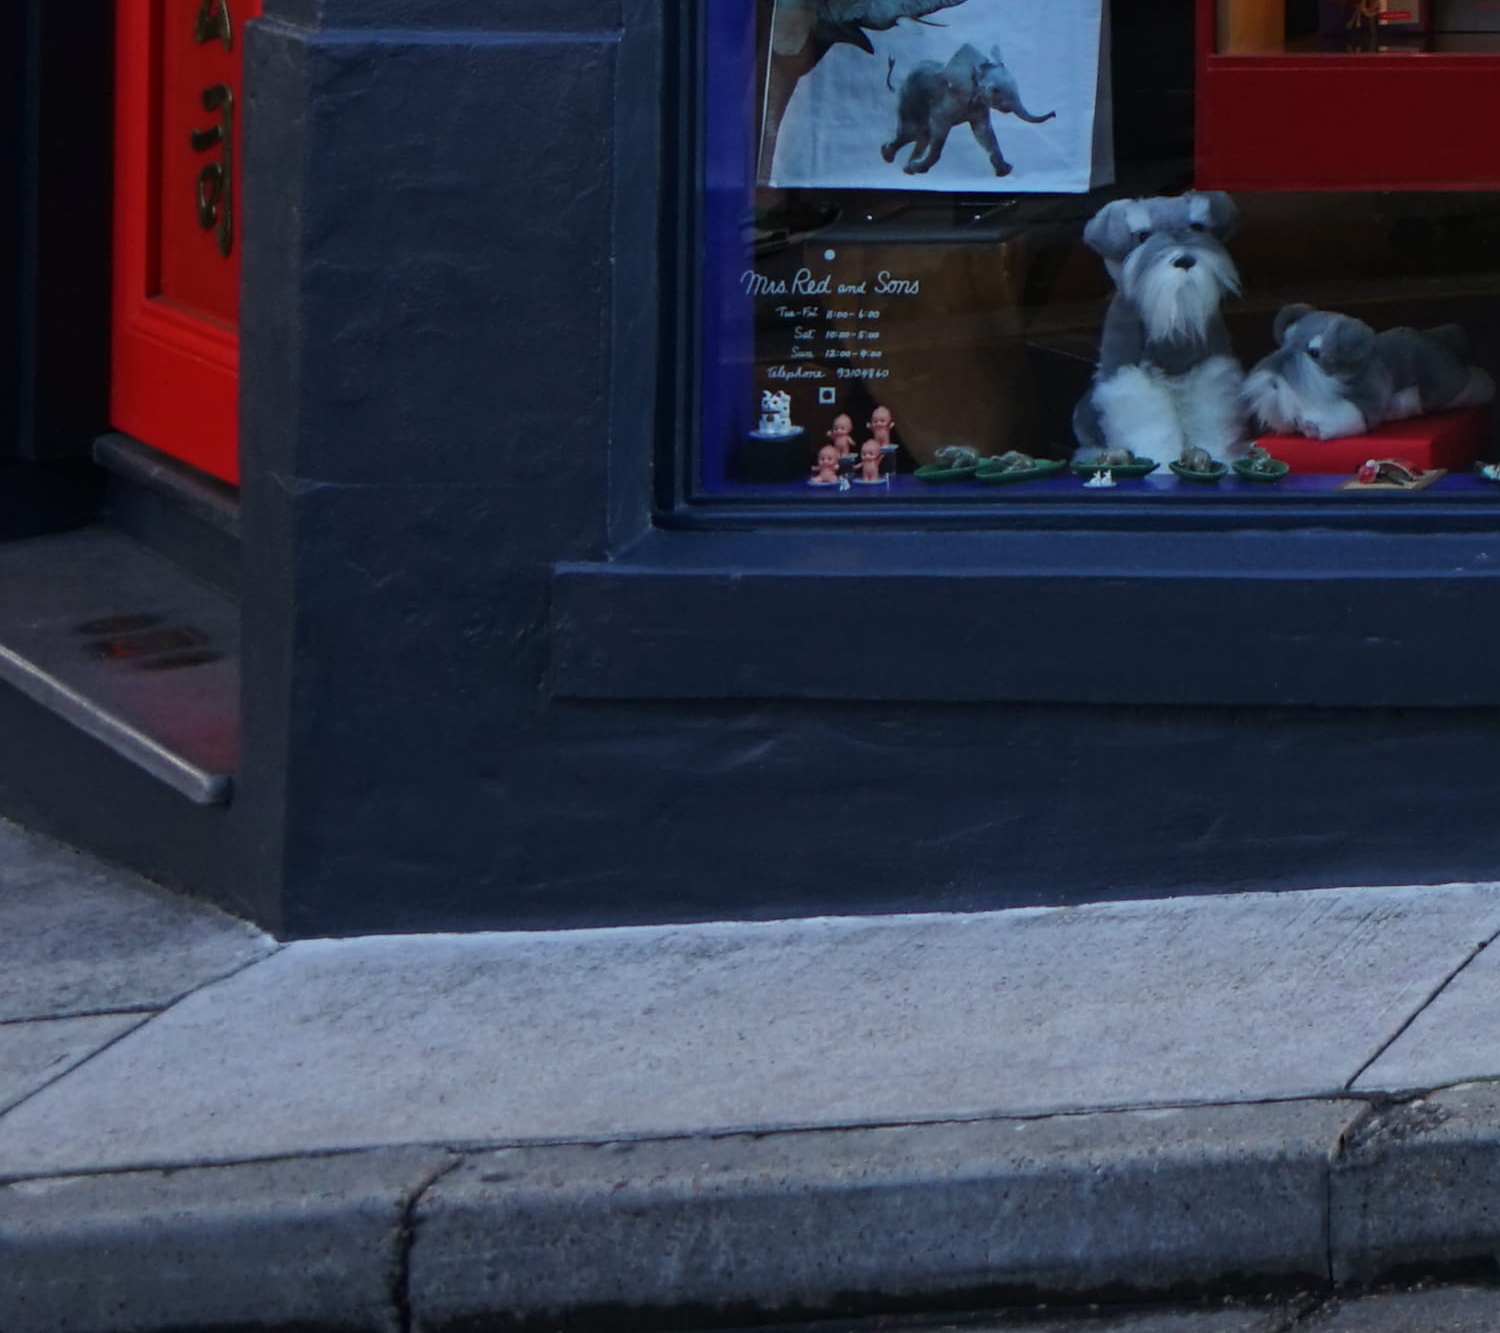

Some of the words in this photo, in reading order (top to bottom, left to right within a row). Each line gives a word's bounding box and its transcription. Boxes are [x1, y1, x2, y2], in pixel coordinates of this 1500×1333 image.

[739, 269, 789, 296] Mrs
[791, 267, 833, 295] Red
[836, 280, 867, 295] and
[873, 269, 921, 295] Sons
